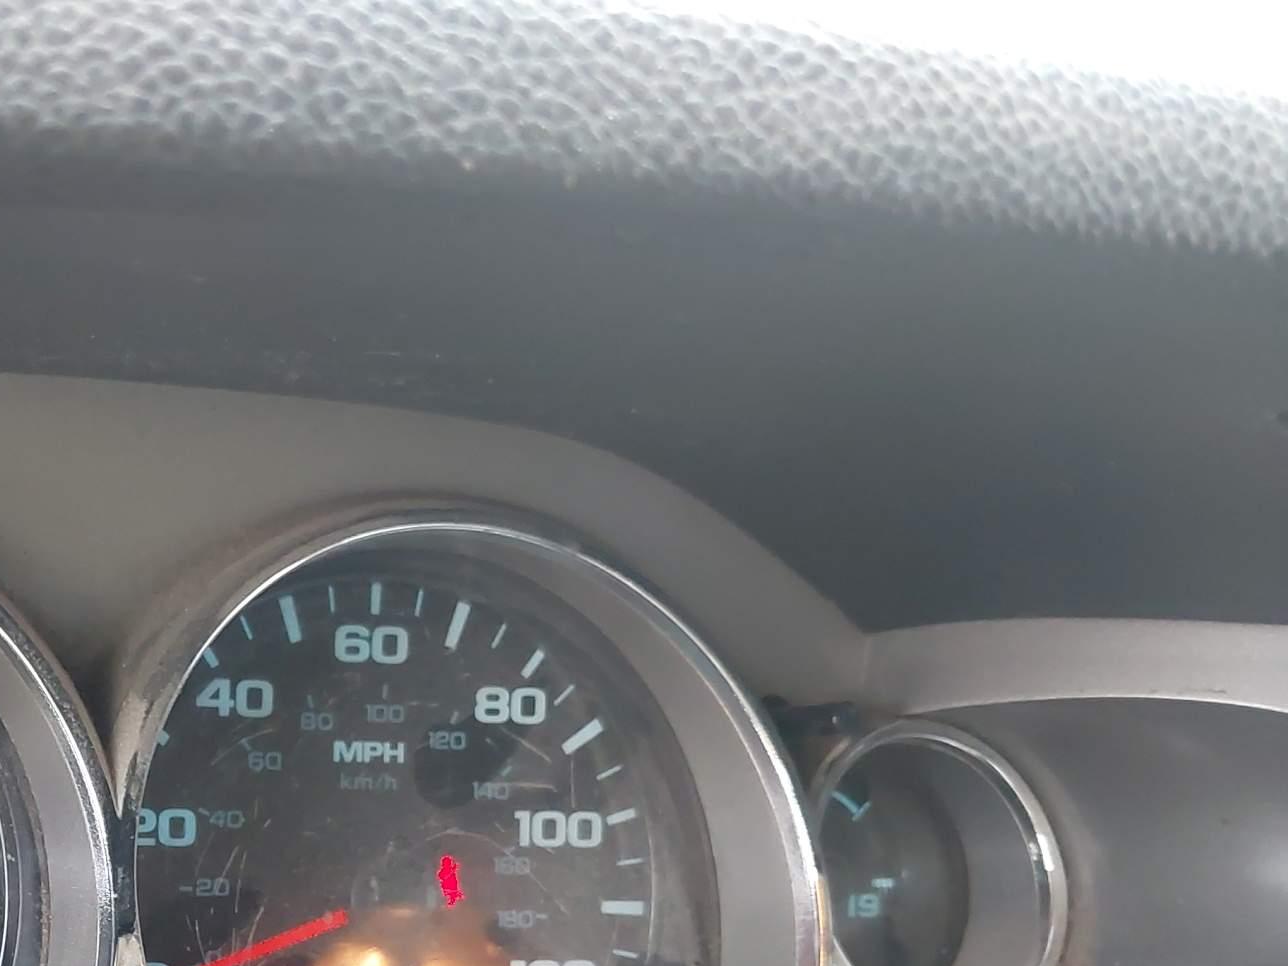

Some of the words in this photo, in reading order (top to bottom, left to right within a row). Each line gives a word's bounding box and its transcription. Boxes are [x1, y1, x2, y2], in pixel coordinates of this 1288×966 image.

[334, 626, 409, 664] 60
[196, 679, 273, 718] 40
[474, 686, 546, 724] 80
[300, 713, 333, 731] 80
[365, 705, 404, 723] 100
[428, 732, 466, 750] 120
[248, 752, 282, 771] 60
[333, 741, 405, 763] MPH
[340, 773, 397, 791] km/h
[137, 808, 197, 847] 20
[210, 810, 244, 828] 40
[514, 810, 602, 848] 100
